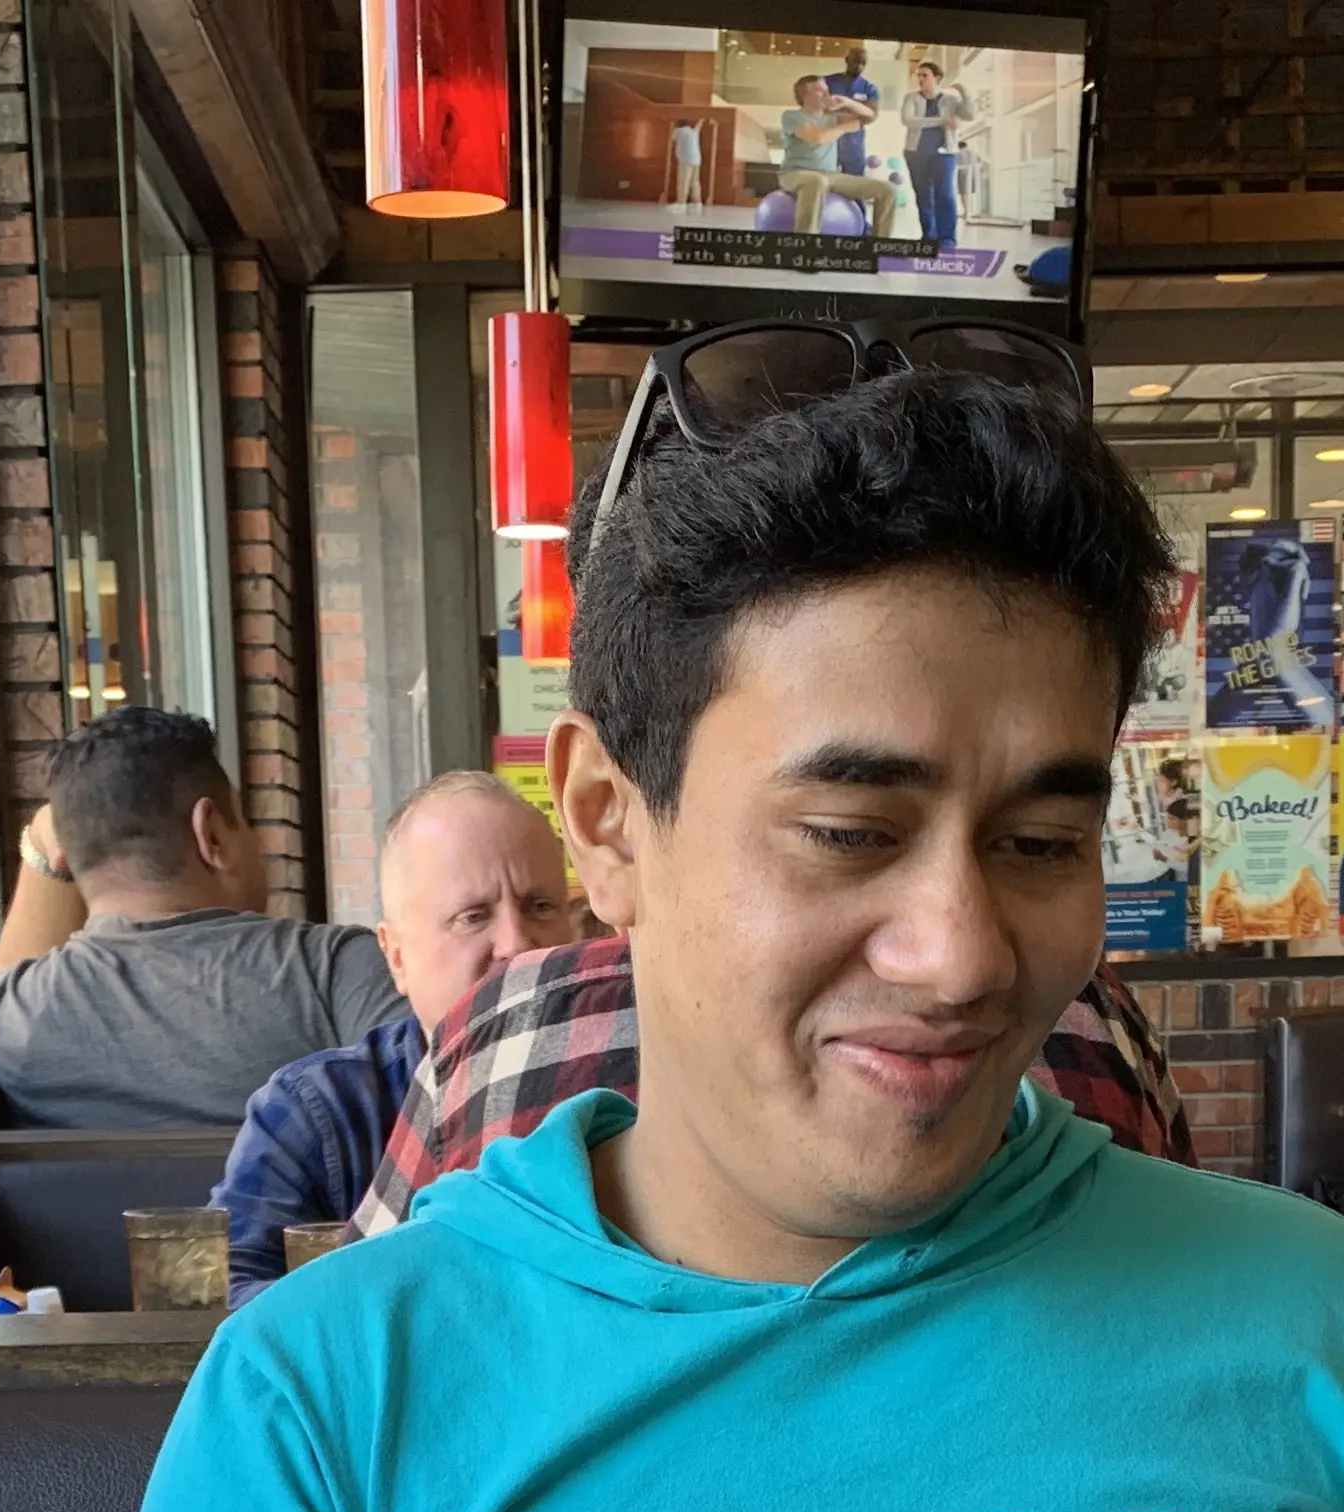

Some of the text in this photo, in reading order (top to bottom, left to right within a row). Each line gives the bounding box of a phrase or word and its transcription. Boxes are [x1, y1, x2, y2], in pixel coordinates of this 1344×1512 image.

[777, 237, 823, 249] isn't
[835, 239, 863, 251] for
[874, 242, 933, 256] people
[723, 252, 764, 267] type
[774, 253, 782, 265] 1
[792, 255, 872, 270] diabetes
[1224, 664, 1260, 688] THE
[1217, 794, 1319, 822] Baked!
